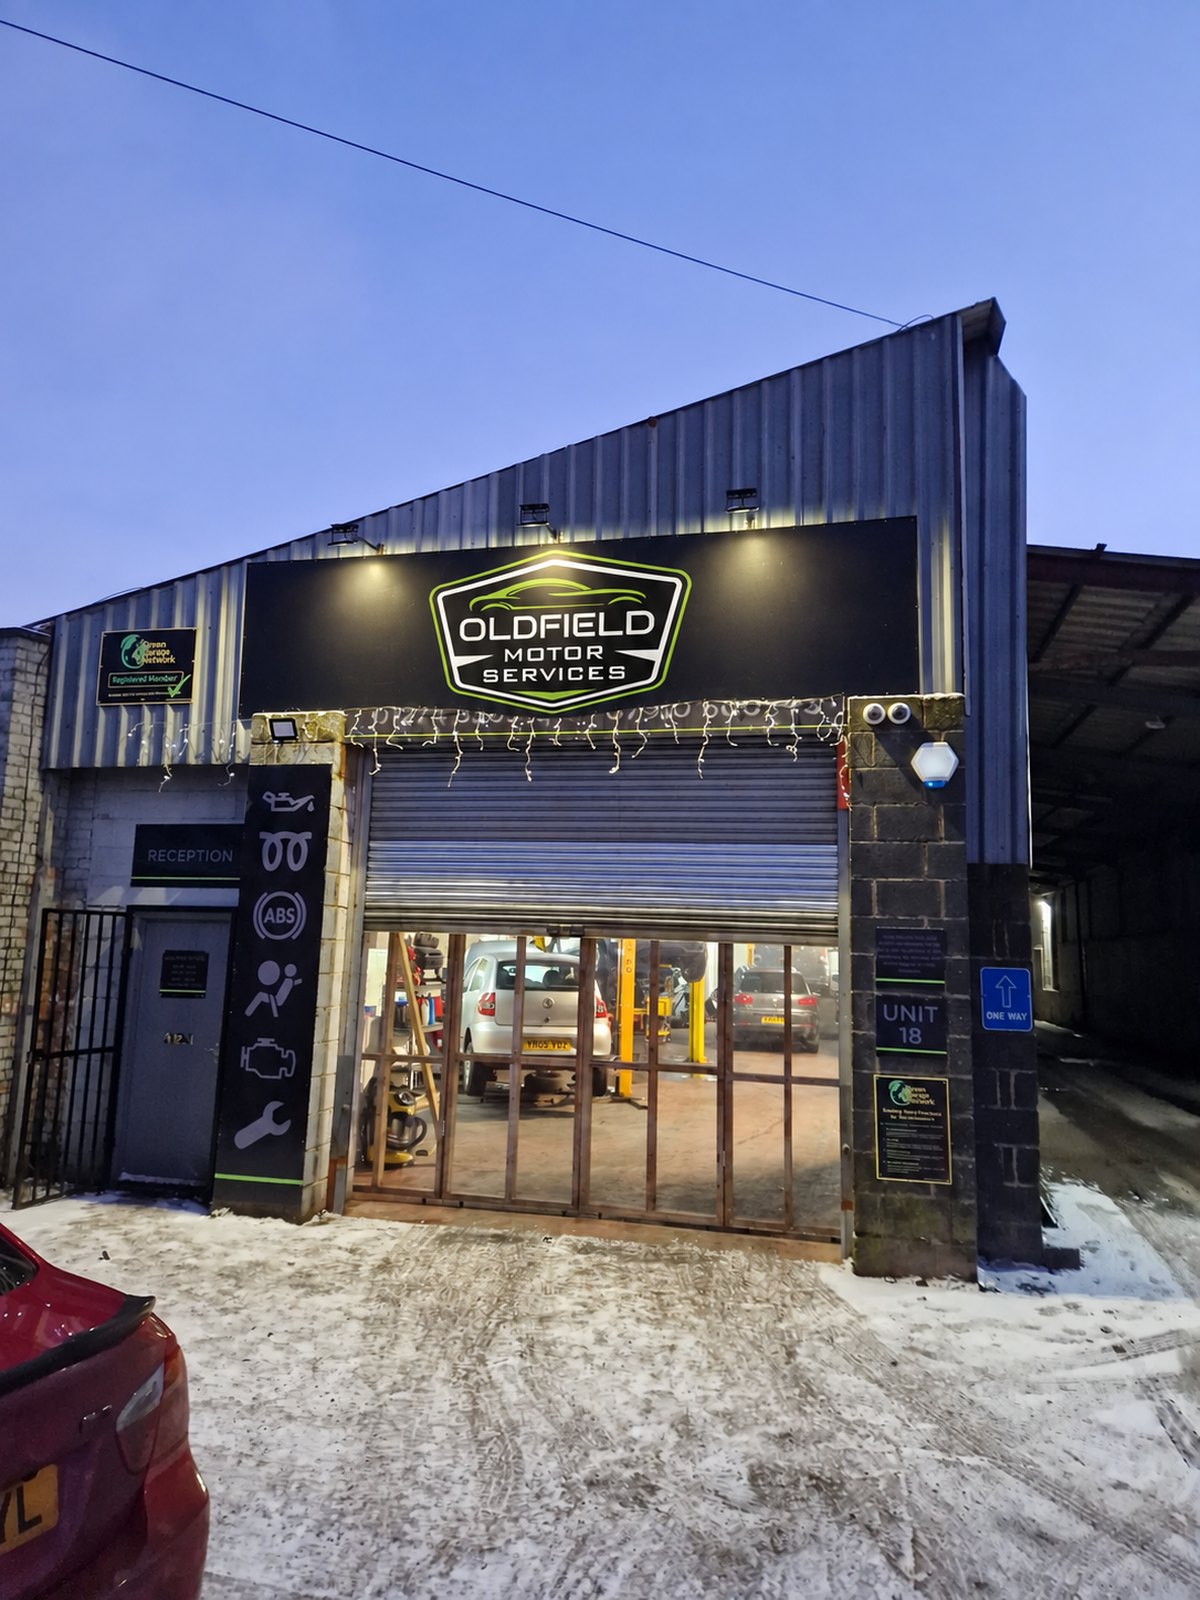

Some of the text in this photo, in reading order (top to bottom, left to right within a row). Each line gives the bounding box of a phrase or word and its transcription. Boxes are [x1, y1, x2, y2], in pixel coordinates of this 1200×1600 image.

[459, 610, 655, 642] OLDFIELD
[504, 645, 604, 663] MOTOR
[483, 665, 626, 683] SERVICES
[147, 849, 233, 863] RECEPTION
[263, 908, 296, 924] ABS
[883, 1004, 938, 1023] UNIT
[986, 1011, 1028, 1021] ONE WAY
[899, 1027, 922, 1044] 18
